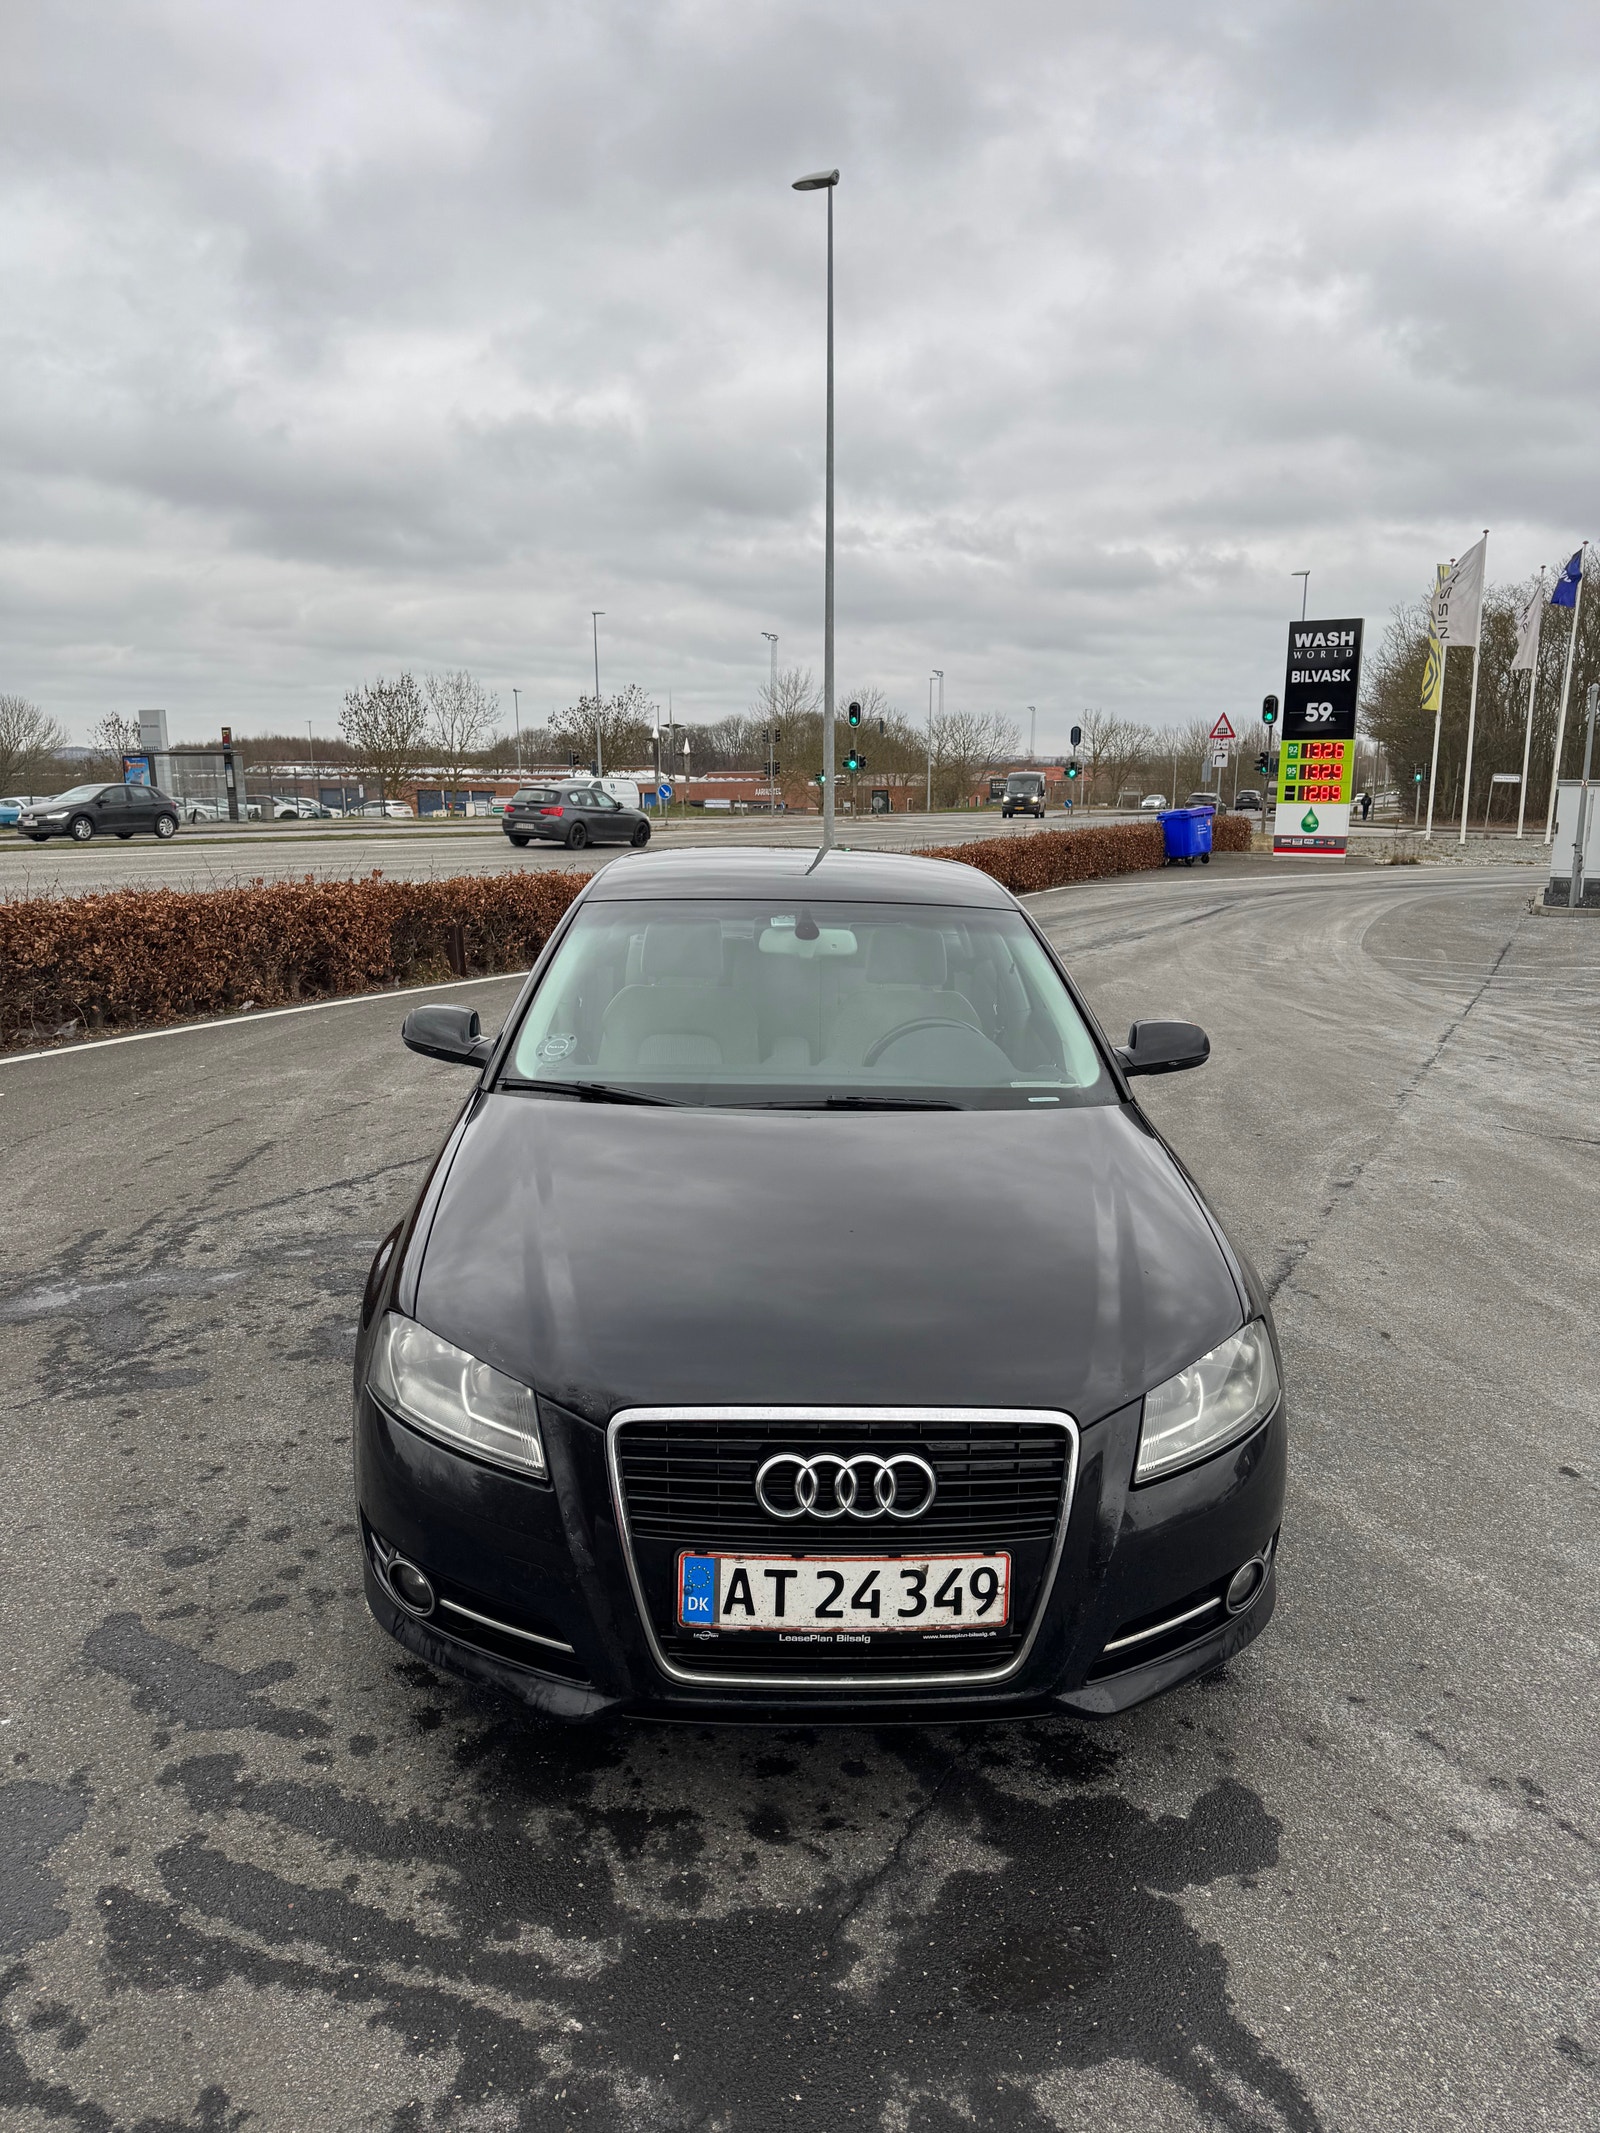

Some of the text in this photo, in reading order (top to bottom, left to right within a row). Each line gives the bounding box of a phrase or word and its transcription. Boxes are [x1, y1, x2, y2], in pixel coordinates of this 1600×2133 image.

[1438, 564, 1460, 639] NISS
[1294, 631, 1355, 648] WASH
[1293, 649, 1354, 659] WORLD
[1291, 669, 1352, 683] BILVASK
[1304, 702, 1333, 722] 59
[1288, 745, 1298, 754] 92
[1286, 767, 1297, 775] 95
[687, 1566, 999, 1618] DK AT 24 349
[778, 1633, 871, 1644] LeasePlan Bilsalg
